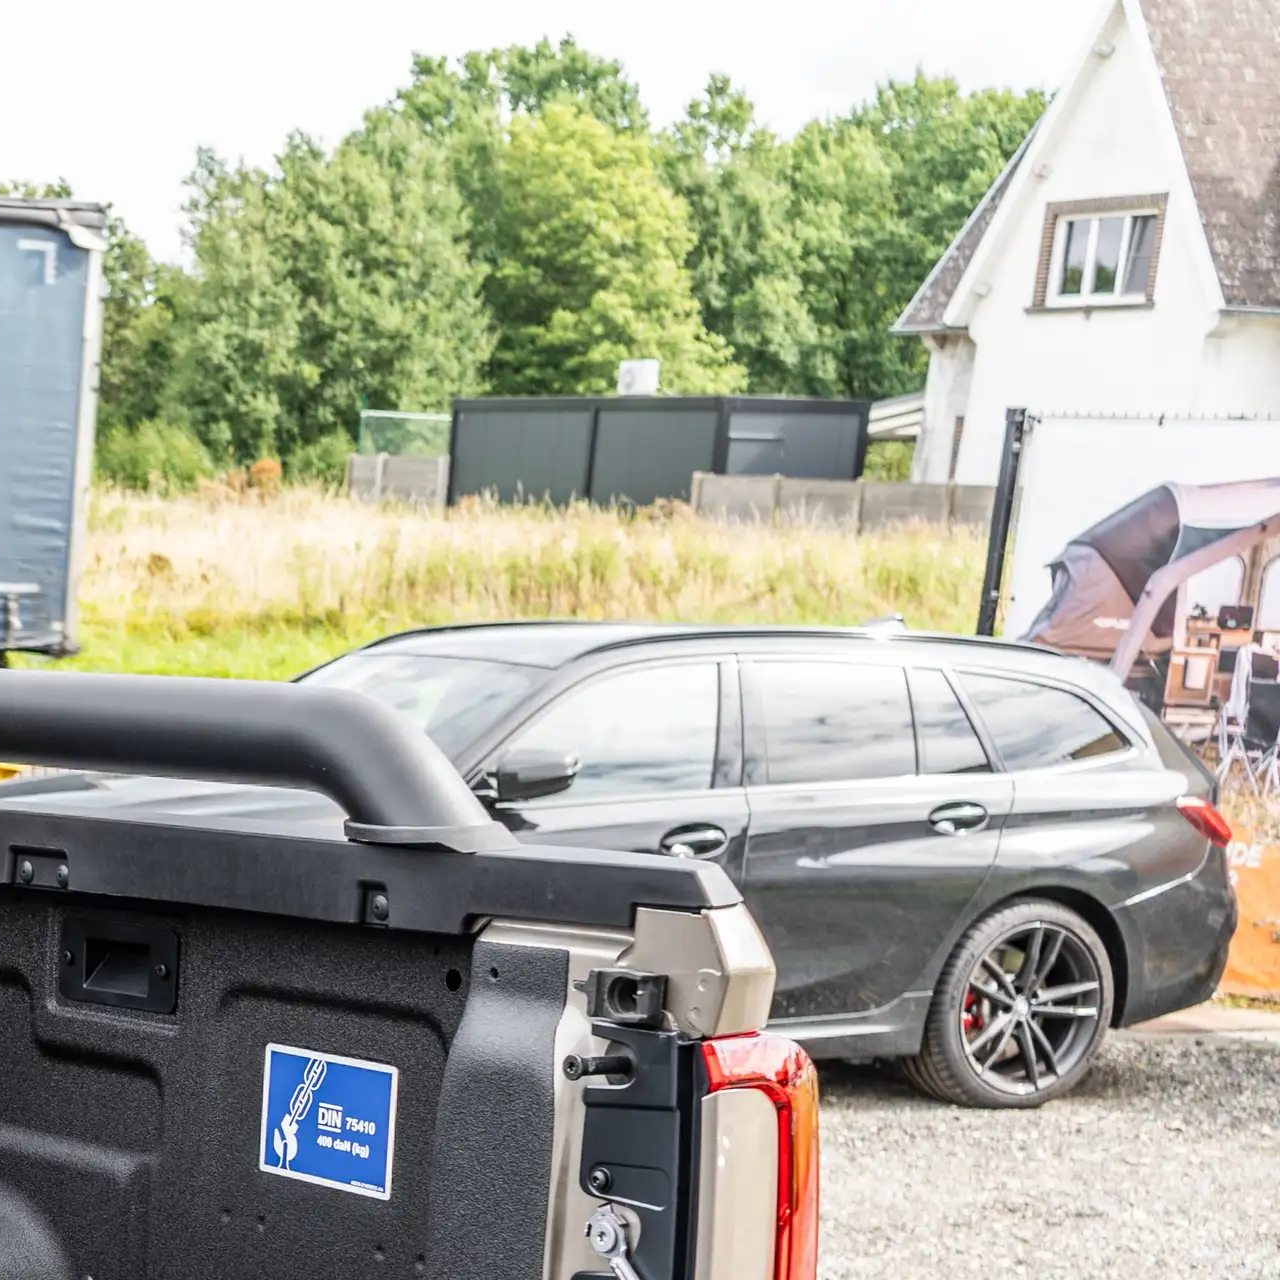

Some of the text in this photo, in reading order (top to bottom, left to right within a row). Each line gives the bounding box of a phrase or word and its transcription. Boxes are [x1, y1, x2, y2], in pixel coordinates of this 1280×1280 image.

[318, 1106, 376, 1135] DIN 75410
[316, 1135, 370, 1159] 400 daN (kg)
